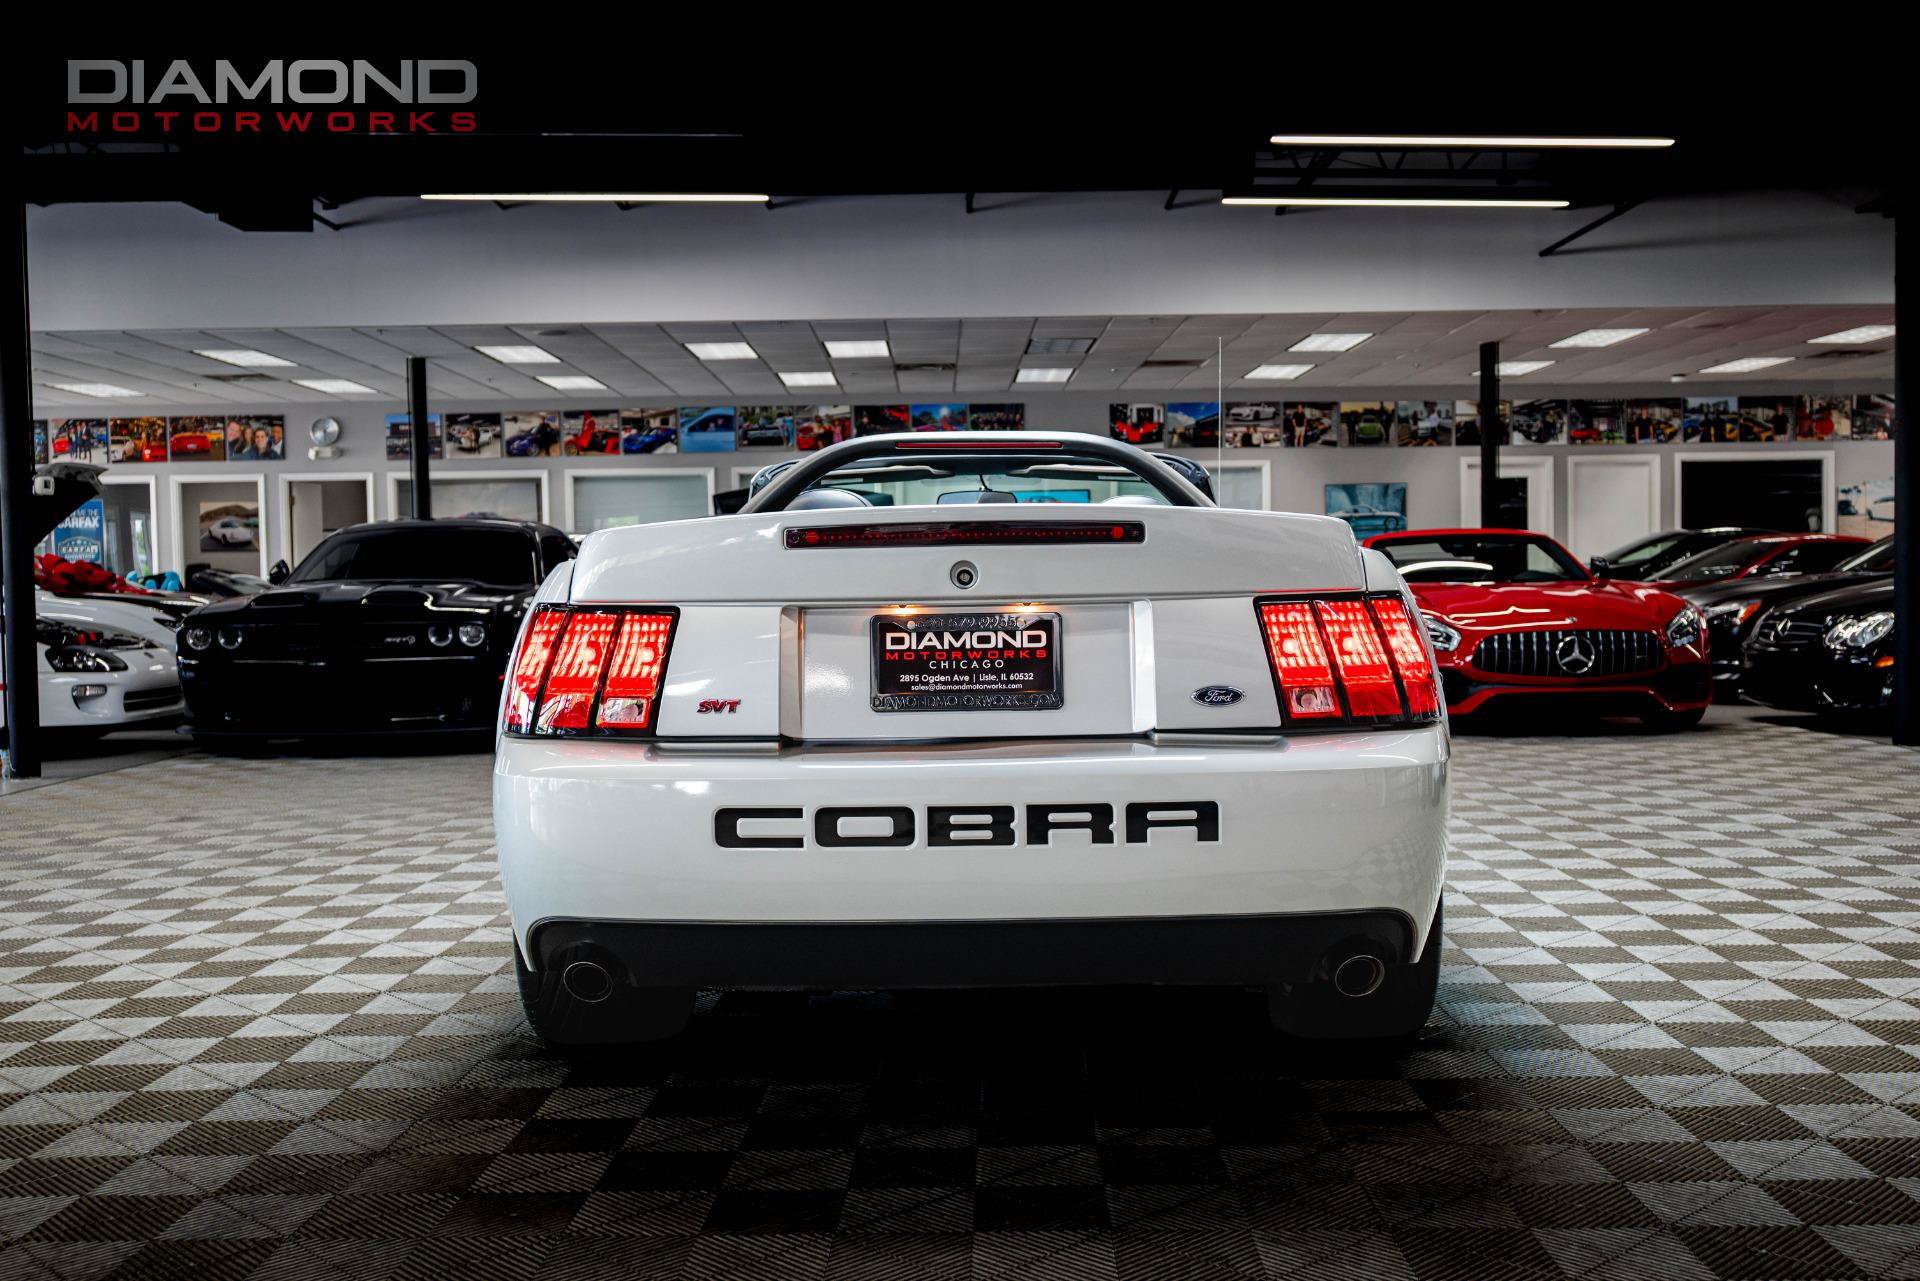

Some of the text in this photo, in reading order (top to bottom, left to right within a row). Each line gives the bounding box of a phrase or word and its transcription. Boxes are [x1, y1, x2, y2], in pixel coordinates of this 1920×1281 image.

[885, 630, 1047, 650] DIAMOND
[885, 650, 1048, 661] MOTORWORKS
[929, 659, 1005, 670] CHICAGO
[900, 674, 920, 682] 2895
[921, 674, 951, 684] Ogden
[952, 674, 970, 682] Ave
[1001, 673, 1008, 681] IL
[1009, 672, 1034, 681] 60532
[911, 682, 1023, 691] sales@diamondmotorworks.com
[1204, 690, 1234, 702] Ford
[697, 699, 741, 714] SVT
[713, 801, 1220, 849] COBRA
